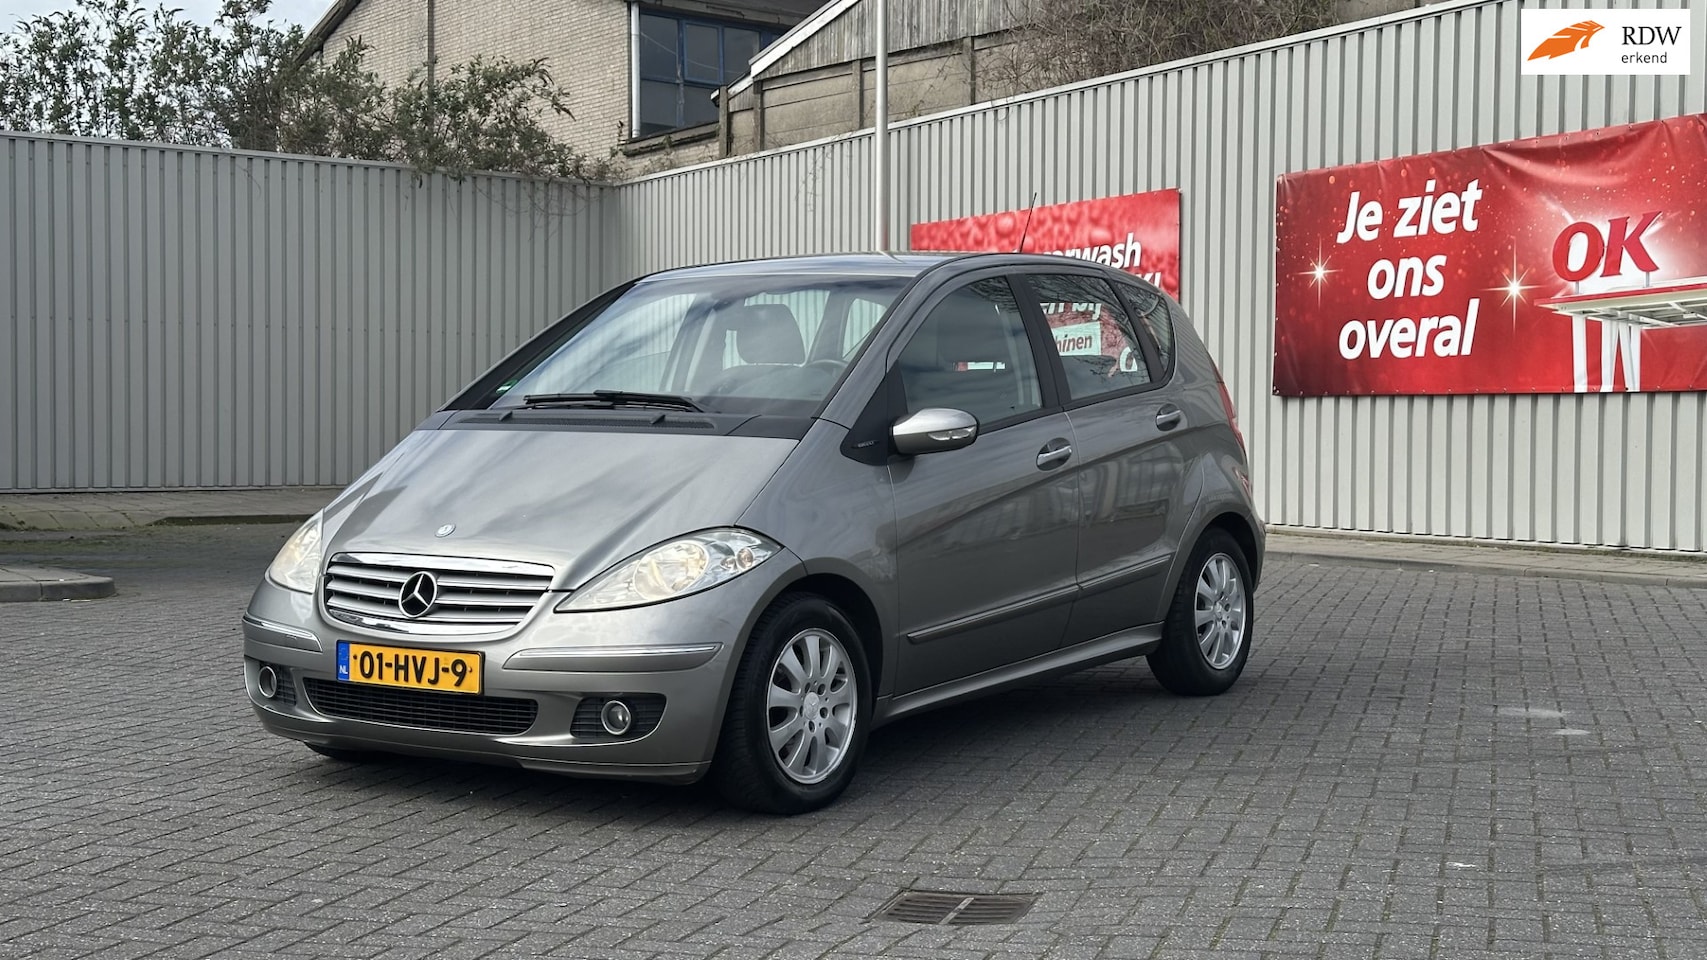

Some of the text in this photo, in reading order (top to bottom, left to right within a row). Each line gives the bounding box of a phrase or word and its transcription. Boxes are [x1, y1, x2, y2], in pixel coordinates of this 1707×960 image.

[1336, 178, 1483, 244] Je ziet
[1366, 254, 1447, 300] ons
[1552, 210, 1663, 283] OK
[1338, 298, 1480, 360] overal
[339, 650, 468, 687] NL 01-HVJ-9
